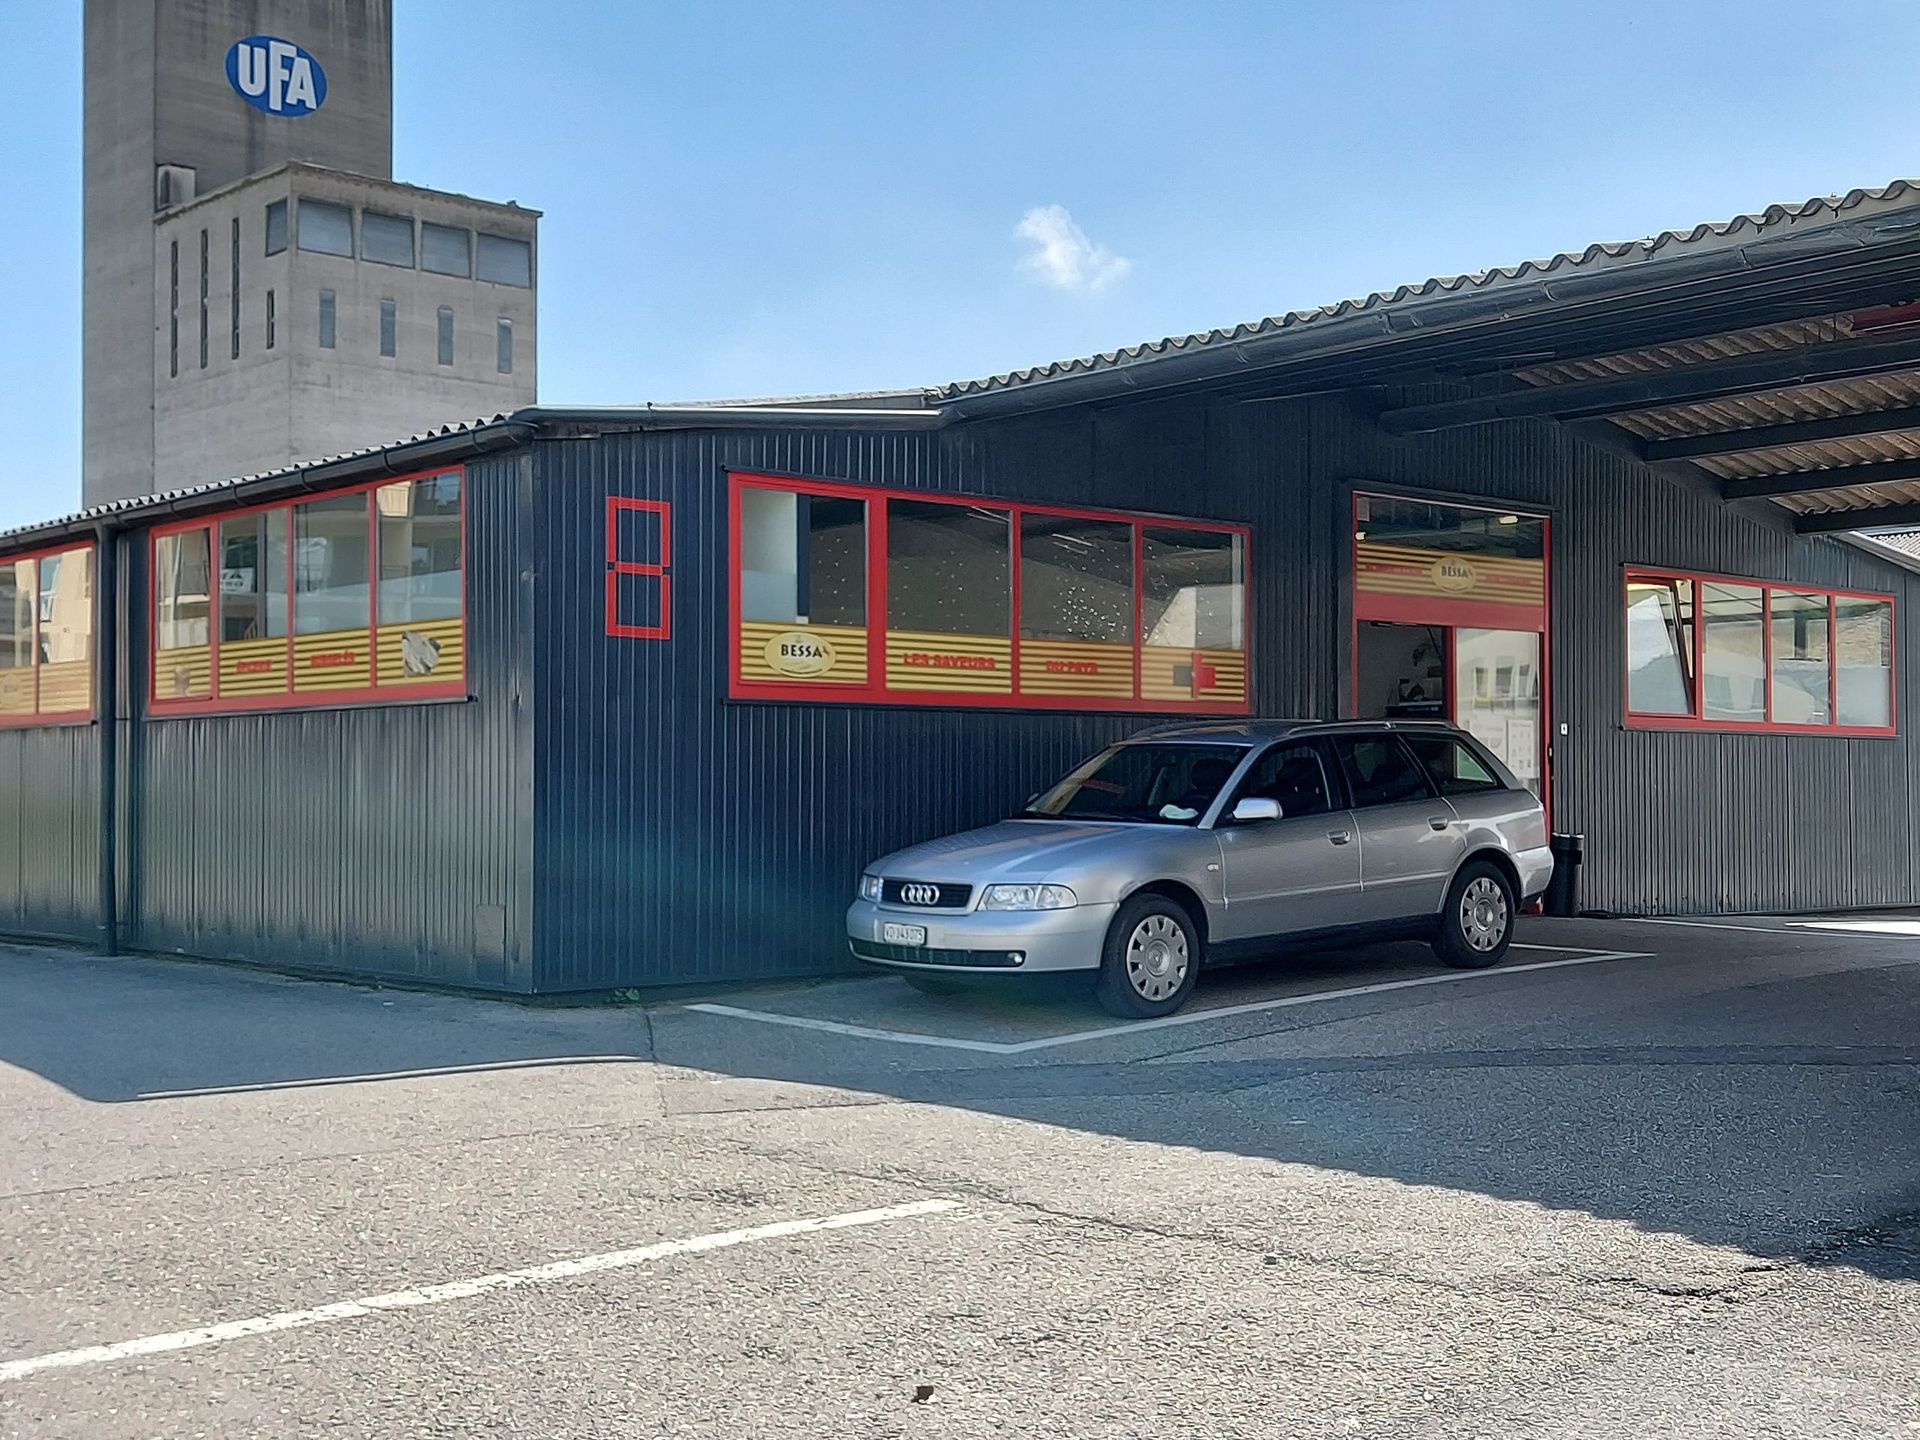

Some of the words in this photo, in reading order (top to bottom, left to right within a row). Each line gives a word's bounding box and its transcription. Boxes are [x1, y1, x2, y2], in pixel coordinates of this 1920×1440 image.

[238, 40, 317, 111] UFA
[1441, 566, 1469, 578] BESSA
[781, 644, 822, 658] BESSA
[903, 653, 929, 666] LES
